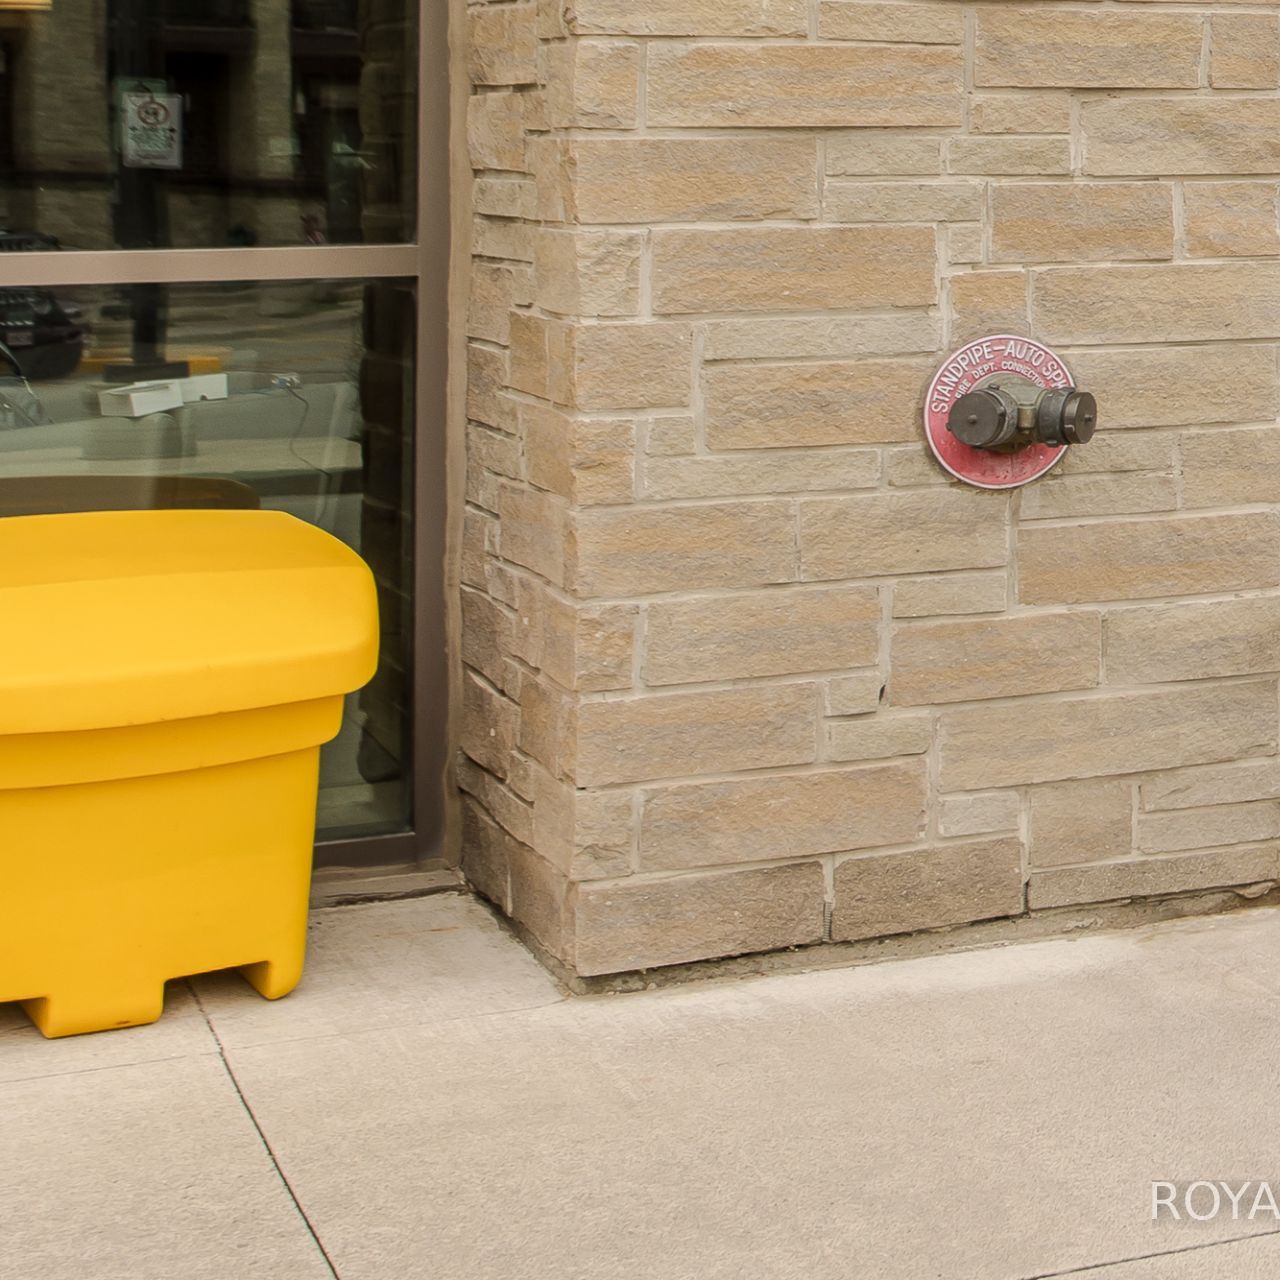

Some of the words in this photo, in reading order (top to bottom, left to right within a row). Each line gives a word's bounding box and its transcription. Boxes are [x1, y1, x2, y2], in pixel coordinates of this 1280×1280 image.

[954, 378, 972, 399] FIRE
[971, 361, 998, 380] DEPT.
[1001, 360, 1046, 389] CONNECTIO
